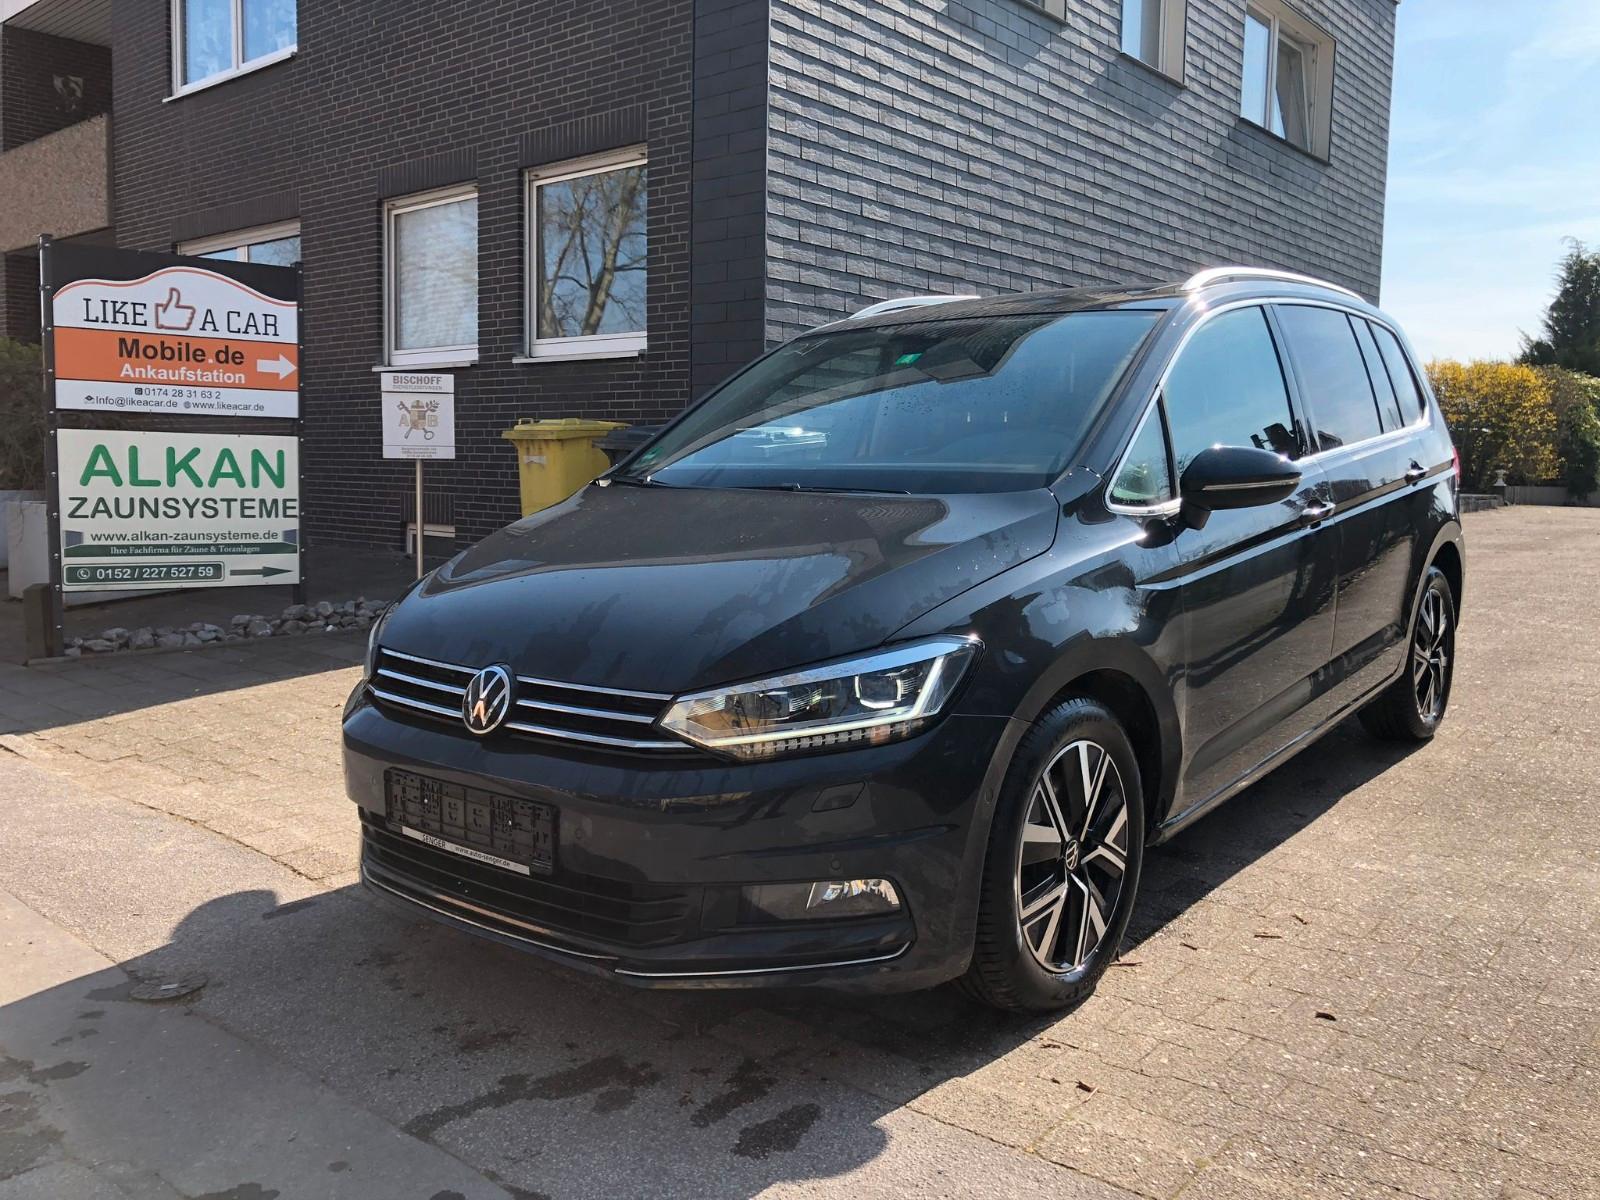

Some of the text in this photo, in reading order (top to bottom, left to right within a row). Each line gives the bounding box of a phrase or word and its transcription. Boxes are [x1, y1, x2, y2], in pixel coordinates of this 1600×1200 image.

[83, 298, 279, 336] LIKE A CAR
[118, 338, 244, 365] Mobile.de
[120, 363, 245, 384] Ankaufstation
[392, 375, 442, 385] BISCHOFF
[144, 388, 221, 399] 0174 28 31 63 2
[192, 400, 264, 411] www.likeacar.de
[79, 444, 285, 488] ALKAN
[67, 497, 298, 519] ZAUNSYSTEME
[90, 530, 278, 543] www.alkan-zaunsysteme.de
[110, 546, 128, 555] Ihre
[130, 545, 169, 555] Fachfirma
[96, 568, 131, 579] 0152
[142, 567, 166, 578] 227
[170, 567, 194, 577] 527
[198, 566, 214, 577] 59
[422, 834, 446, 849] SENGER
